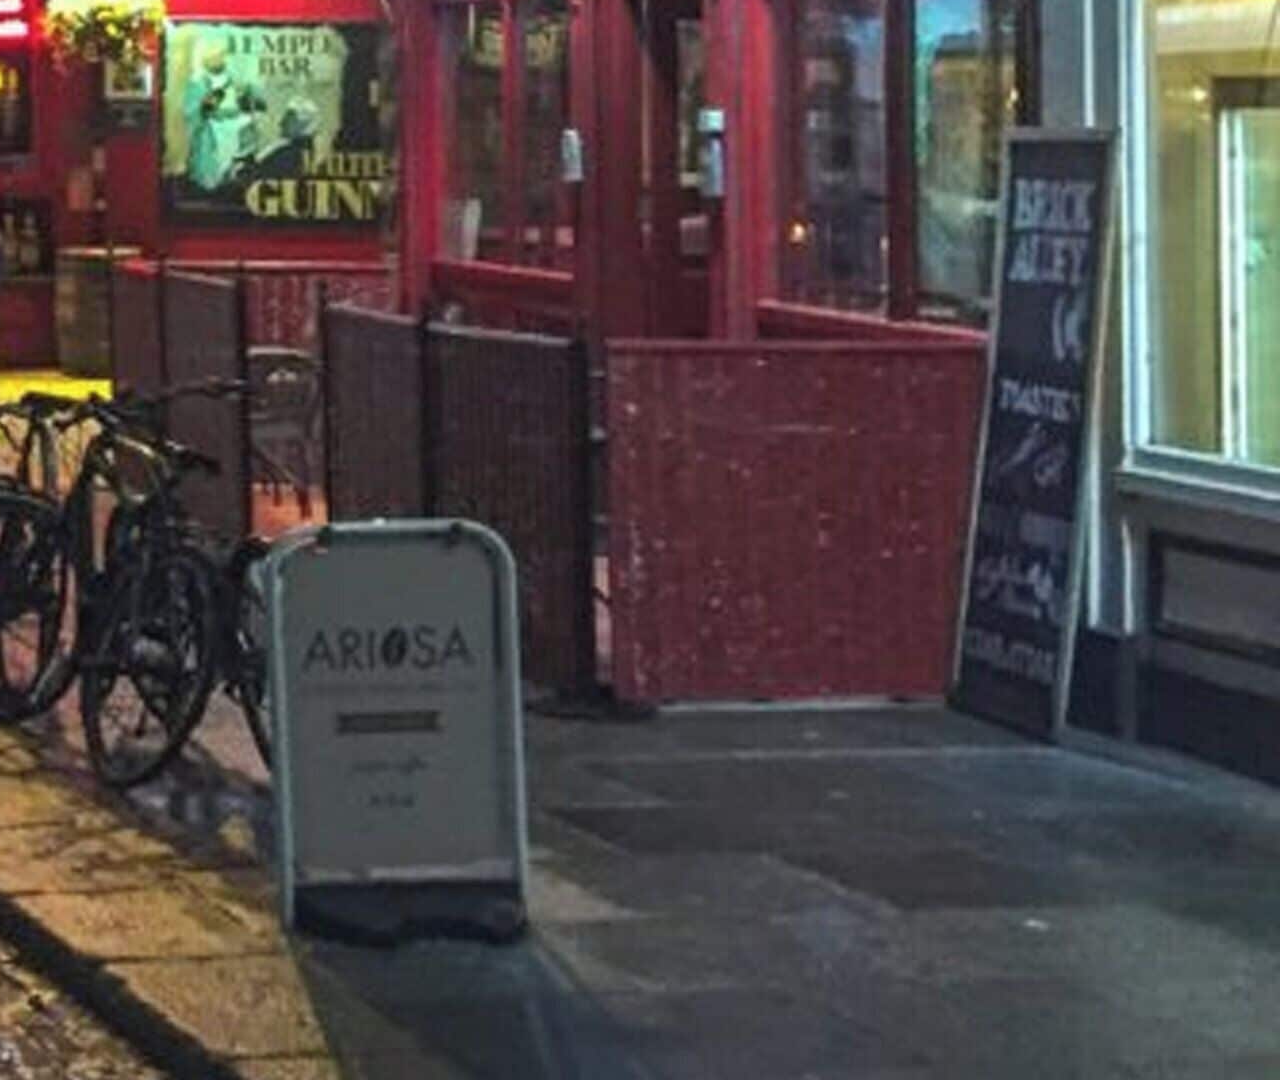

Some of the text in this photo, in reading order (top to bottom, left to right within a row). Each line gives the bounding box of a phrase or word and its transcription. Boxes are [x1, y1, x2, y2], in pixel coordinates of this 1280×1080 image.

[227, 33, 333, 55] TEMPLE
[258, 57, 312, 77] BAR
[301, 623, 477, 672] ARIOSA
